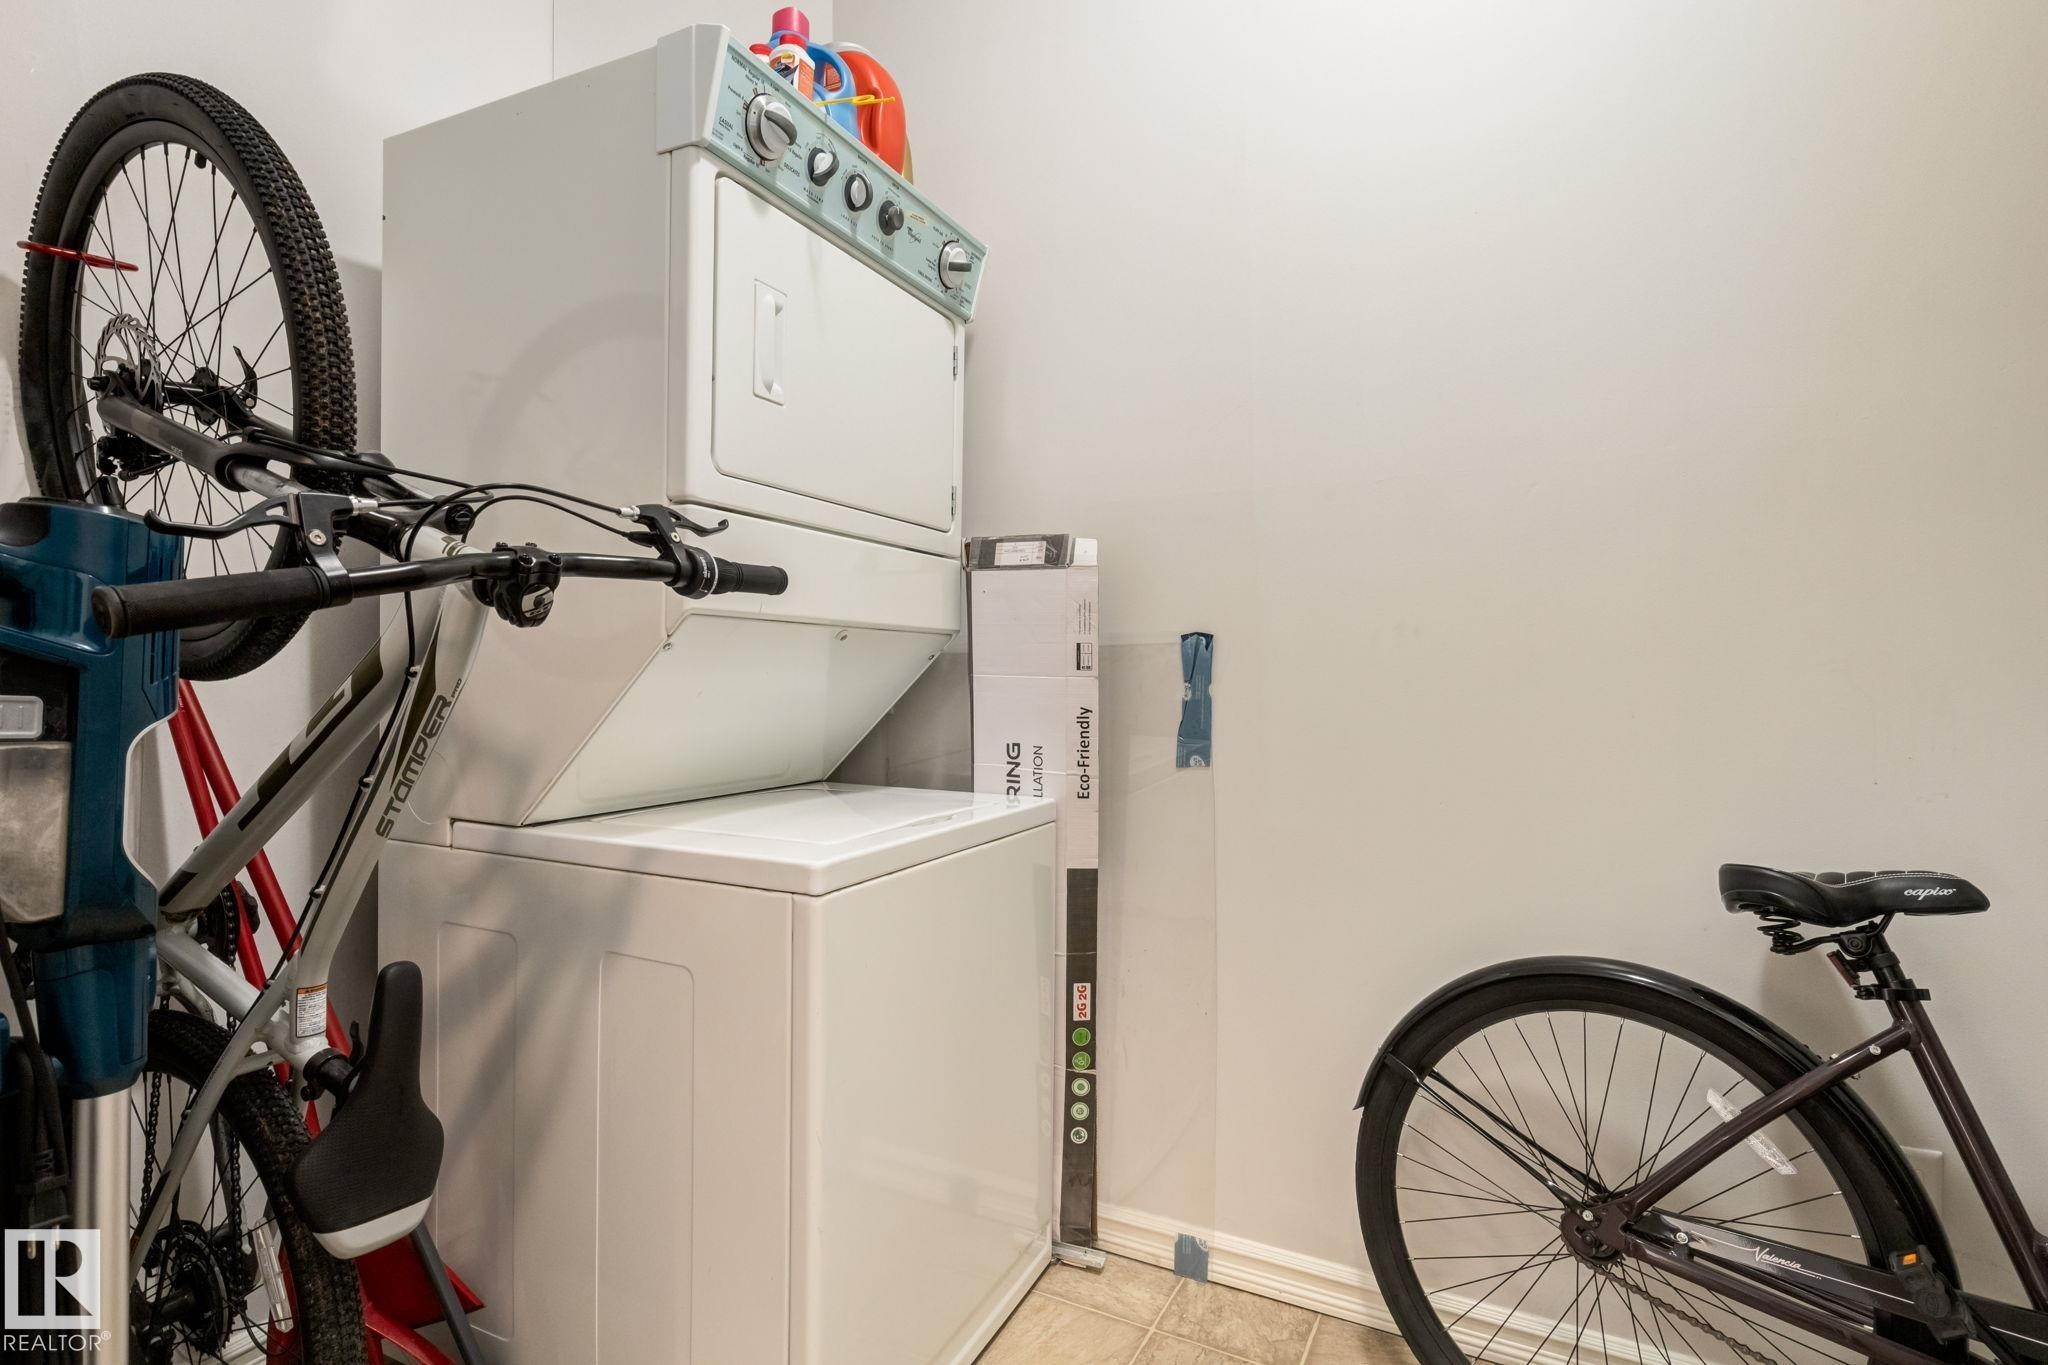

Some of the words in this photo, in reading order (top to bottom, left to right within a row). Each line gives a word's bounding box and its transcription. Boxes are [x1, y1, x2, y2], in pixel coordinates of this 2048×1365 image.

[1076, 706, 1093, 800] Eco-Friendly
[375, 694, 453, 839] STOMPER
[1076, 984, 1087, 1001] 2G
[1076, 1002, 1087, 1019] 2G
[1754, 1246, 1802, 1269] Valencia
